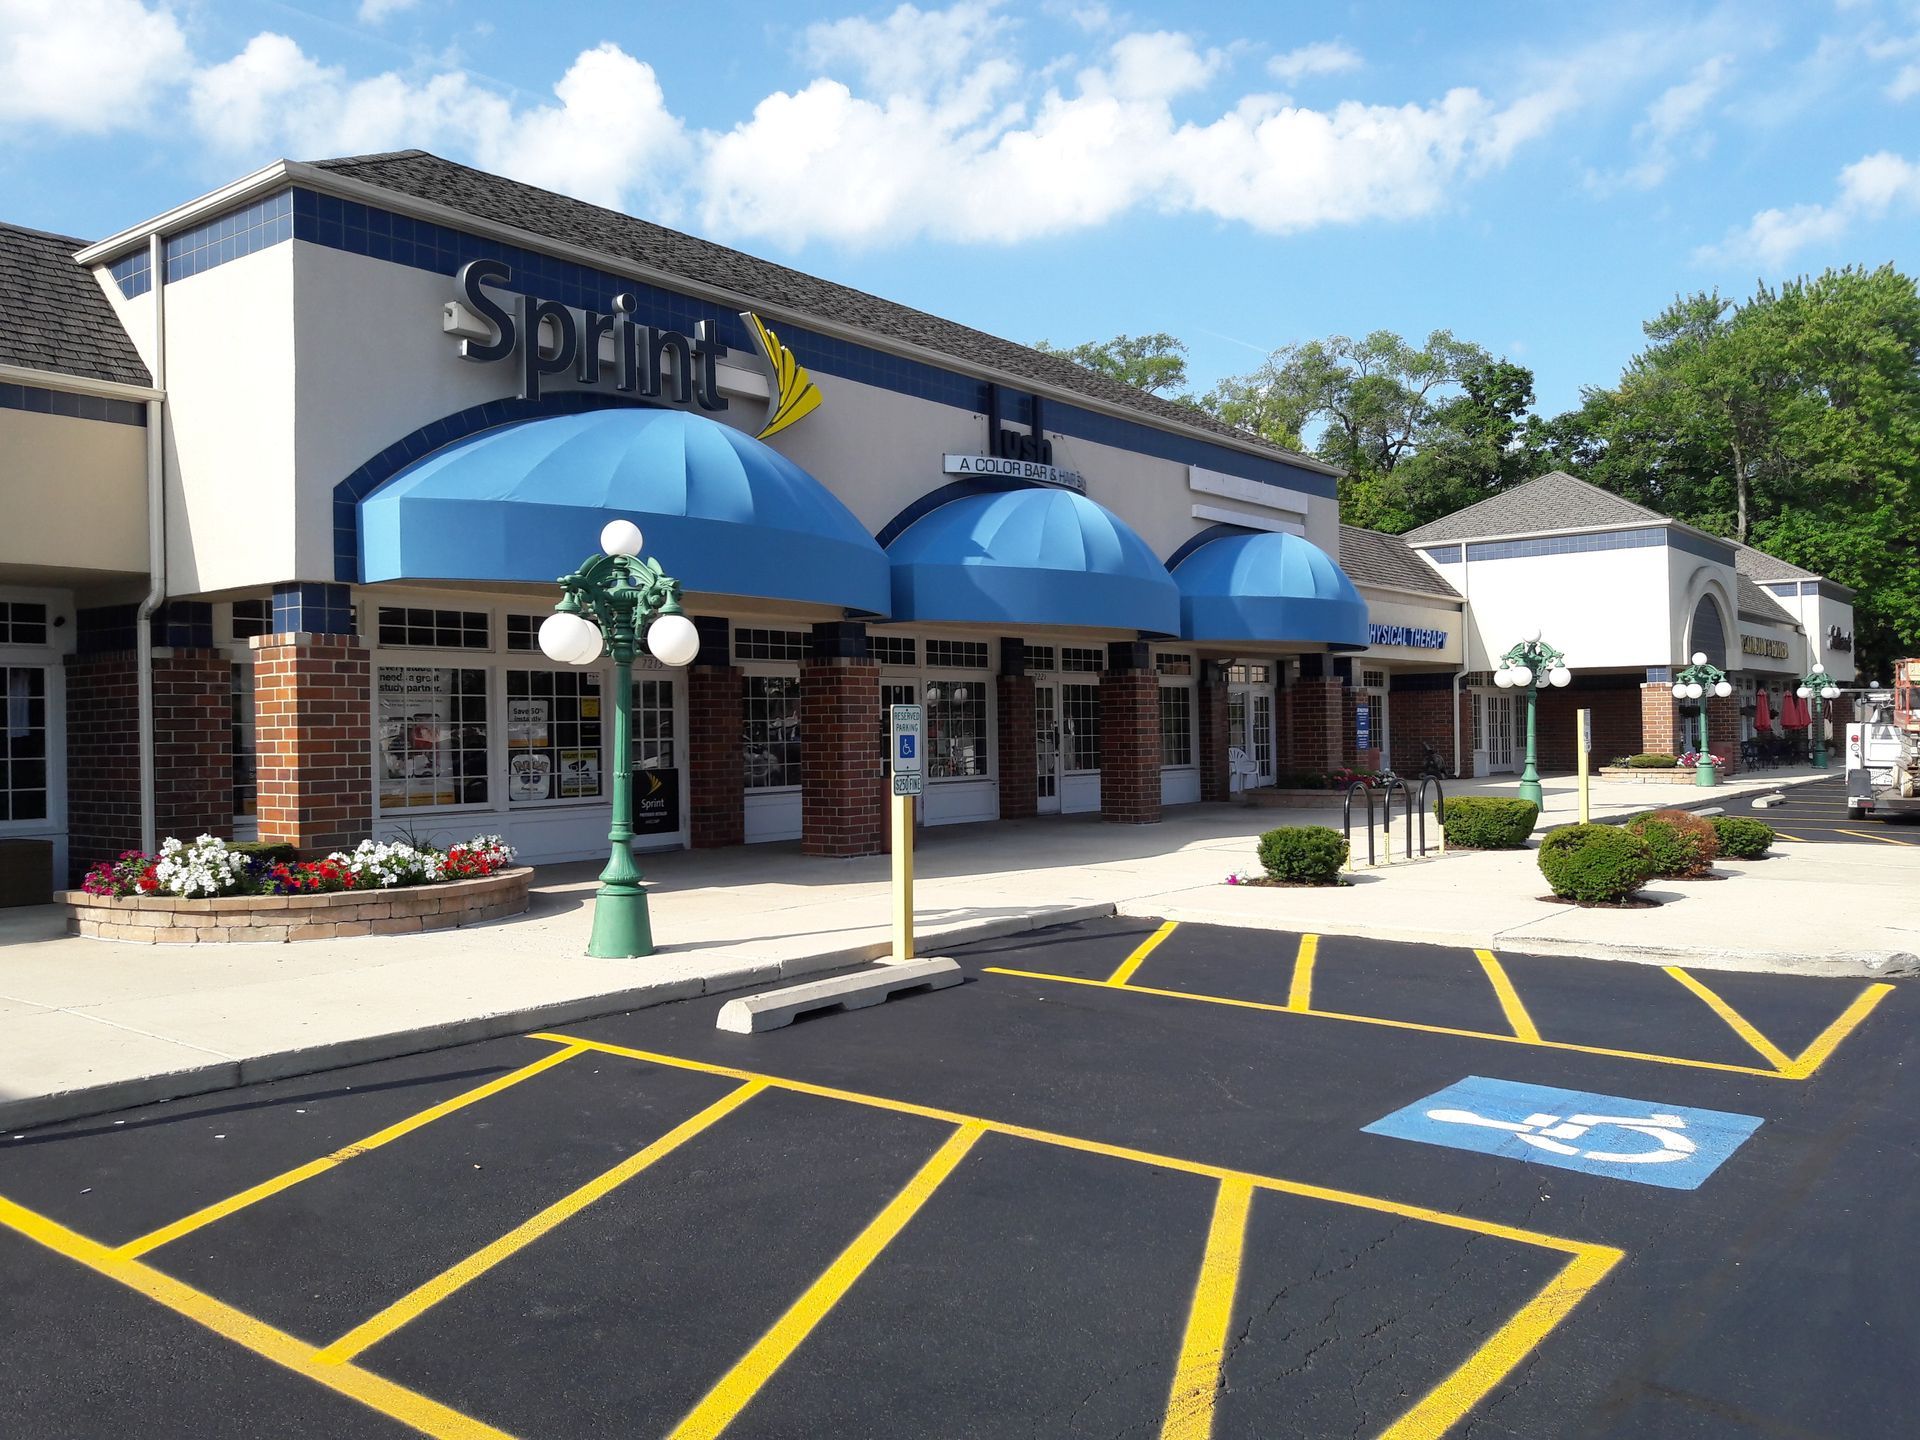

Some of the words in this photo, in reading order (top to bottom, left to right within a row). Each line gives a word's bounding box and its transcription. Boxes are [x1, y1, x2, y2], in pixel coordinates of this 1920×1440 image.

[457, 259, 728, 411] Sprint
[960, 458, 970, 471] A
[975, 459, 1021, 475] COLOR
[1025, 464, 1047, 479] BAR
[1050, 468, 1057, 480] &
[1369, 624, 1407, 645] HYSICAL
[1410, 628, 1448, 649] THERAPY
[379, 673, 407, 682] need
[416, 675, 440, 683] gret
[379, 684, 404, 693] study
[407, 685, 442, 693] partnr.
[895, 711, 920, 721] RESERVED
[896, 723, 918, 732] PARKING
[896, 779, 909, 791] $250
[909, 778, 921, 791] FINE
[641, 798, 665, 810] Sprint
